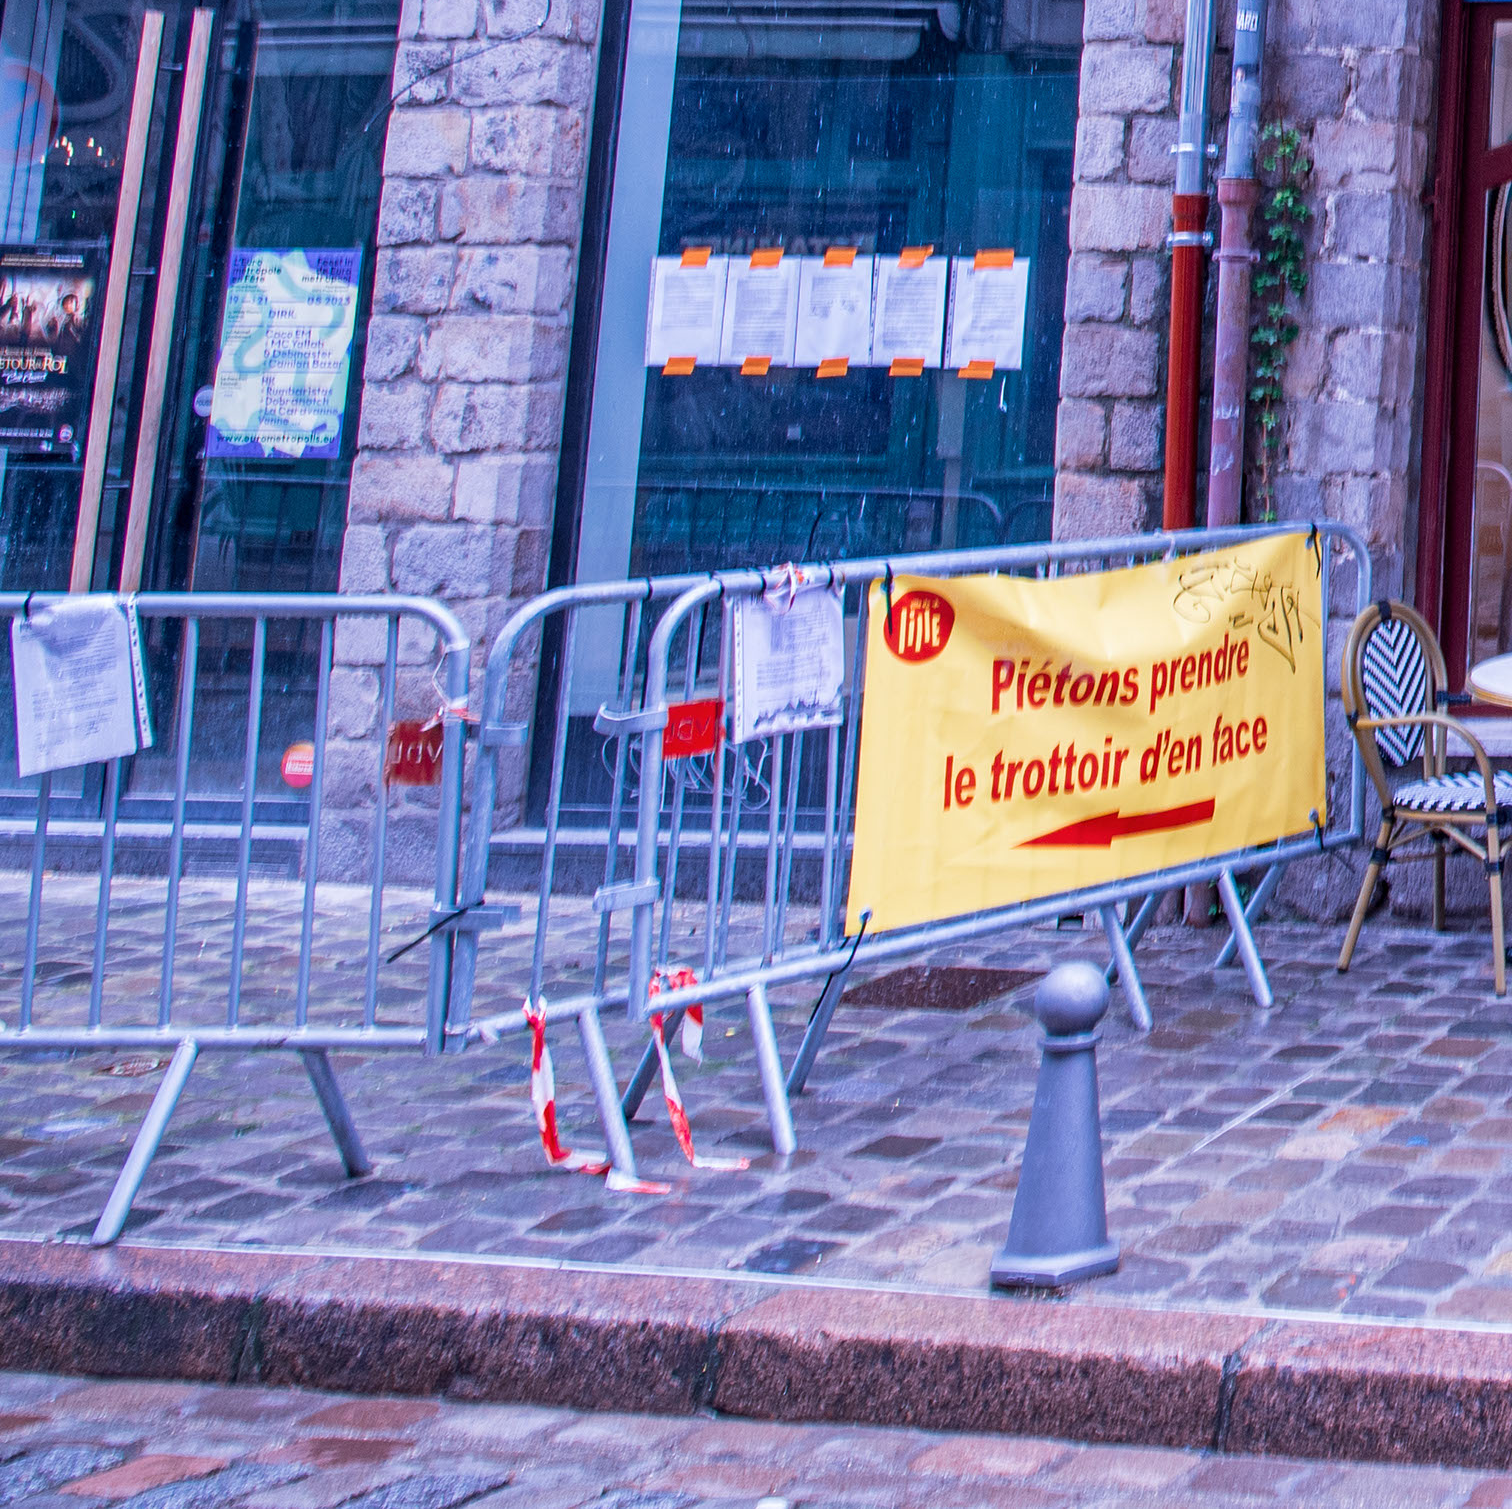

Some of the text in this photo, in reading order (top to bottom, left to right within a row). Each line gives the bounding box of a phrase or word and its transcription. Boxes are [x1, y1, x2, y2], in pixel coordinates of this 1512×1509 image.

[265, 329, 293, 339] Coco
[991, 633, 1250, 719] Piétons prendre
[943, 754, 978, 811] le
[991, 741, 1129, 804] trottoir
[1209, 711, 1268, 769] face
